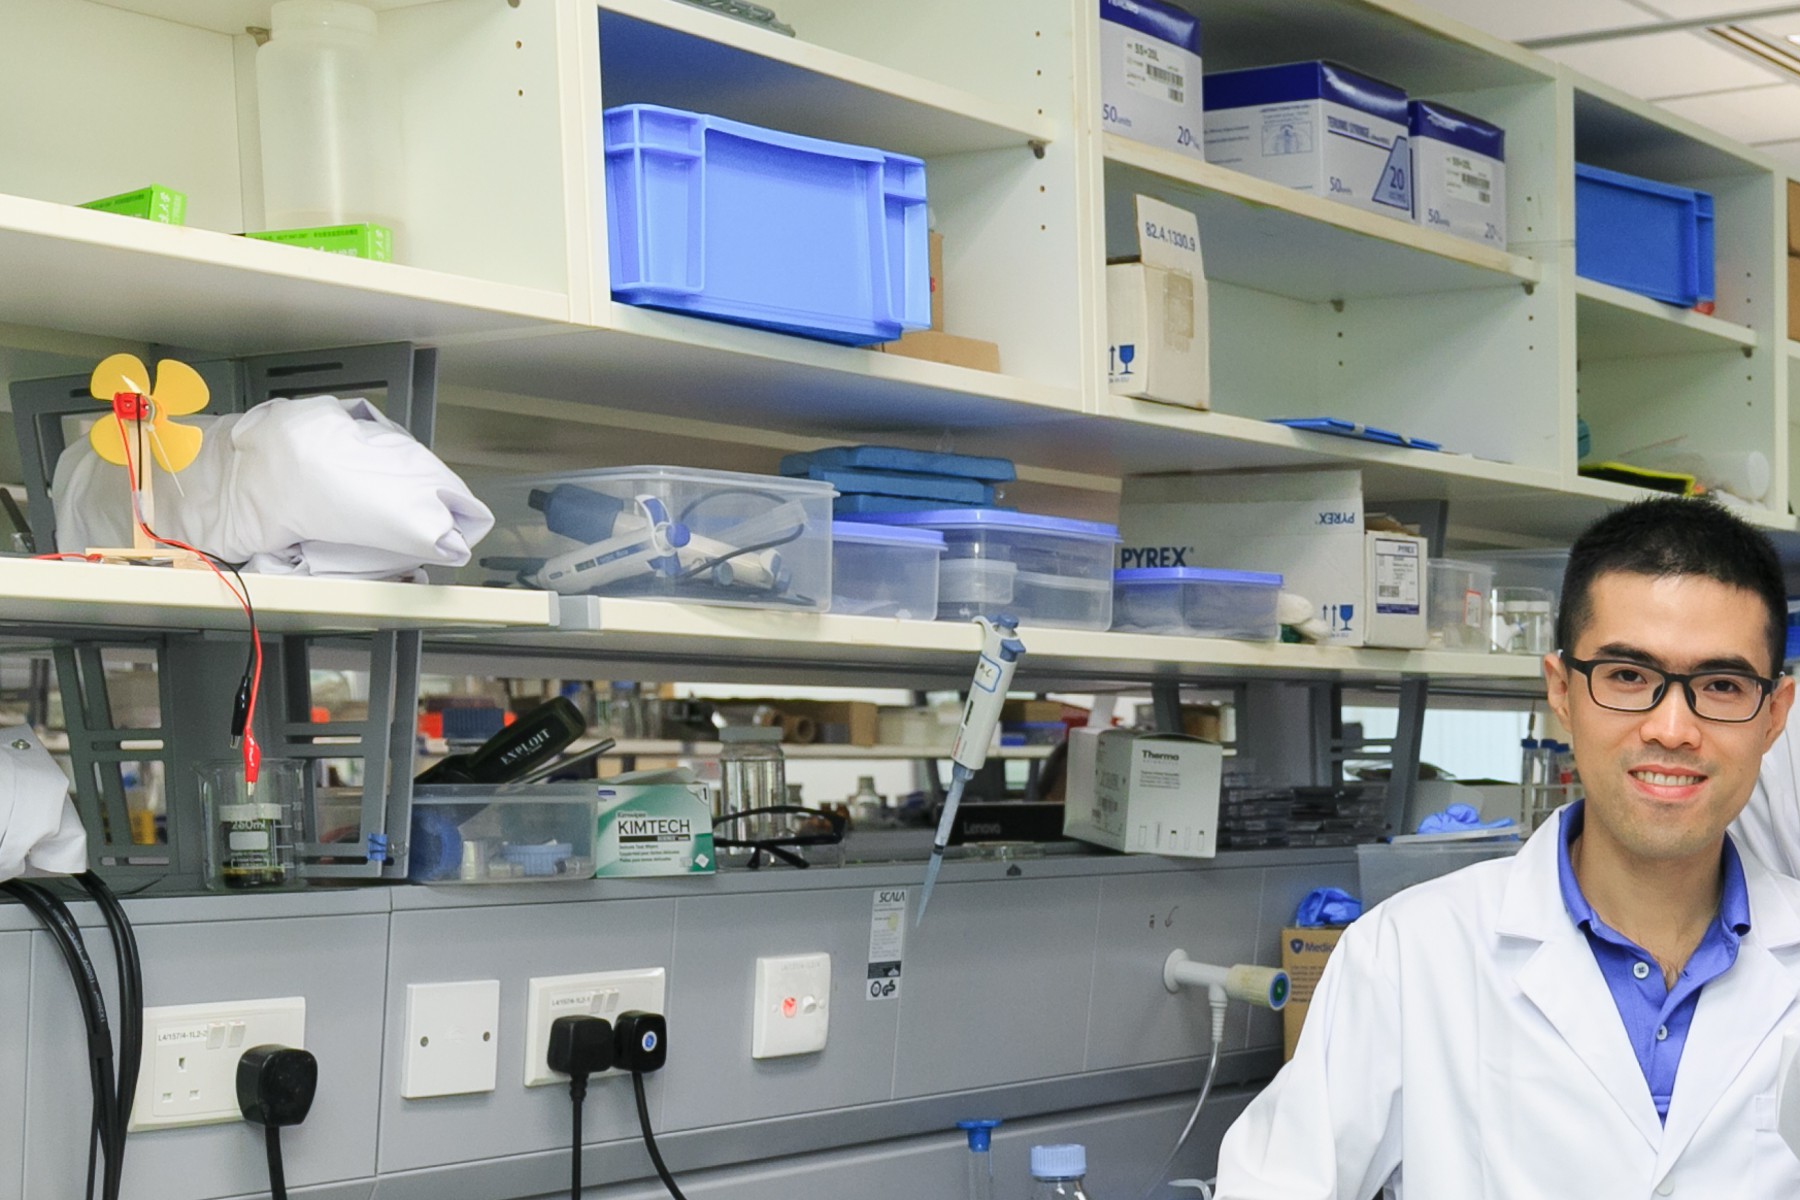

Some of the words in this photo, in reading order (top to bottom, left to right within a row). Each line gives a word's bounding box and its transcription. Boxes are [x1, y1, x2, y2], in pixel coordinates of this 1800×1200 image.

[1103, 103, 1117, 122] 50
[1178, 126, 1191, 146] 20
[1389, 166, 1405, 190] 20
[1145, 222, 1196, 252] 82.4.1330.9
[1319, 512, 1355, 525] PYREX
[1121, 546, 1187, 569] PYREX
[500, 728, 551, 765] EXPLOIT
[1142, 750, 1180, 761] Thermo
[618, 819, 690, 834] KIMTECH
[879, 891, 905, 903] SCALA
